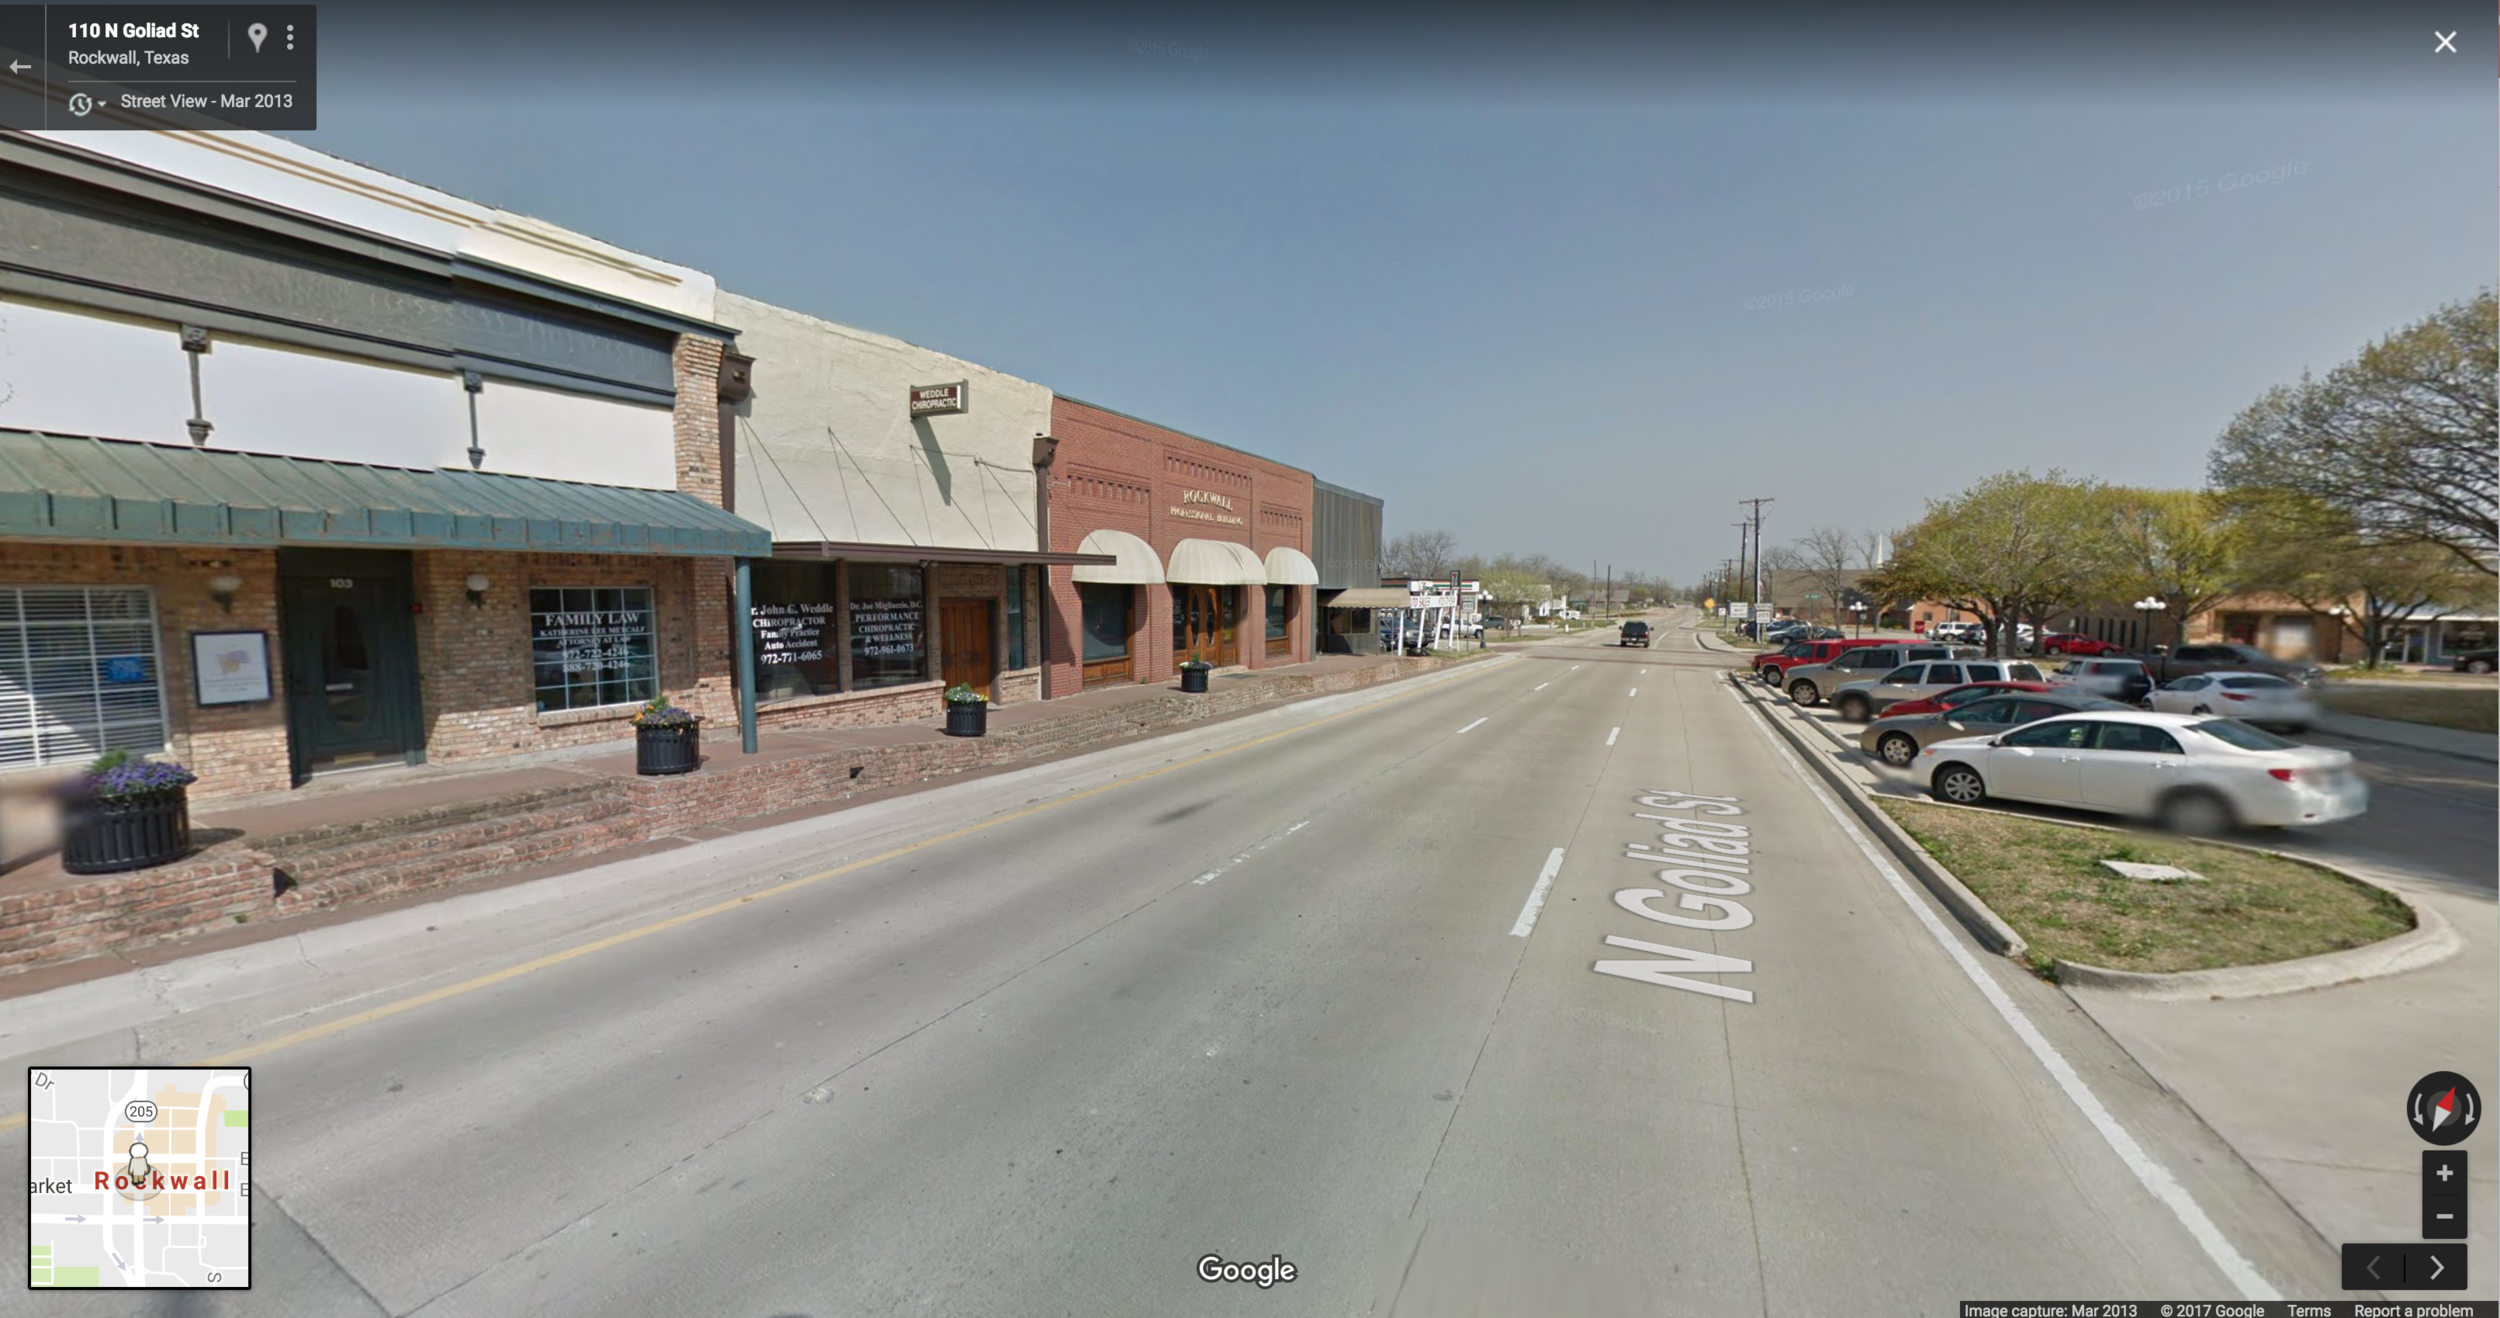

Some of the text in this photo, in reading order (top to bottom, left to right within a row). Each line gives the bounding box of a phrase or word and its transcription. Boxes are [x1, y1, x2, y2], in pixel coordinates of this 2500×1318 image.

[919, 388, 949, 399] WEDDLE
[912, 397, 957, 410] CHIROPRACTIC
[1183, 489, 1233, 512] ROCKWALL
[1170, 506, 1243, 525] PROFESSIONAL BUILDING
[331, 578, 354, 589] 103
[760, 604, 785, 616] John
[787, 603, 799, 614] C.
[800, 603, 834, 614] Weddle
[850, 602, 860, 610] Dr.
[862, 602, 873, 610] Joe
[545, 612, 640, 626] FAMILY LAW
[752, 616, 826, 628] CHIROPRACTOR
[855, 612, 919, 622] PERFORMANCE
[540, 628, 590, 637] KATHERINE
[790, 628, 820, 637] Practice
[859, 623, 915, 633] CHIROPRACTIC
[558, 637, 600, 647] ATTORNEY
[873, 633, 913, 642] WELLNESS
[764, 639, 818, 650] Auto Accident
[760, 650, 823, 665] 972-771-6065
